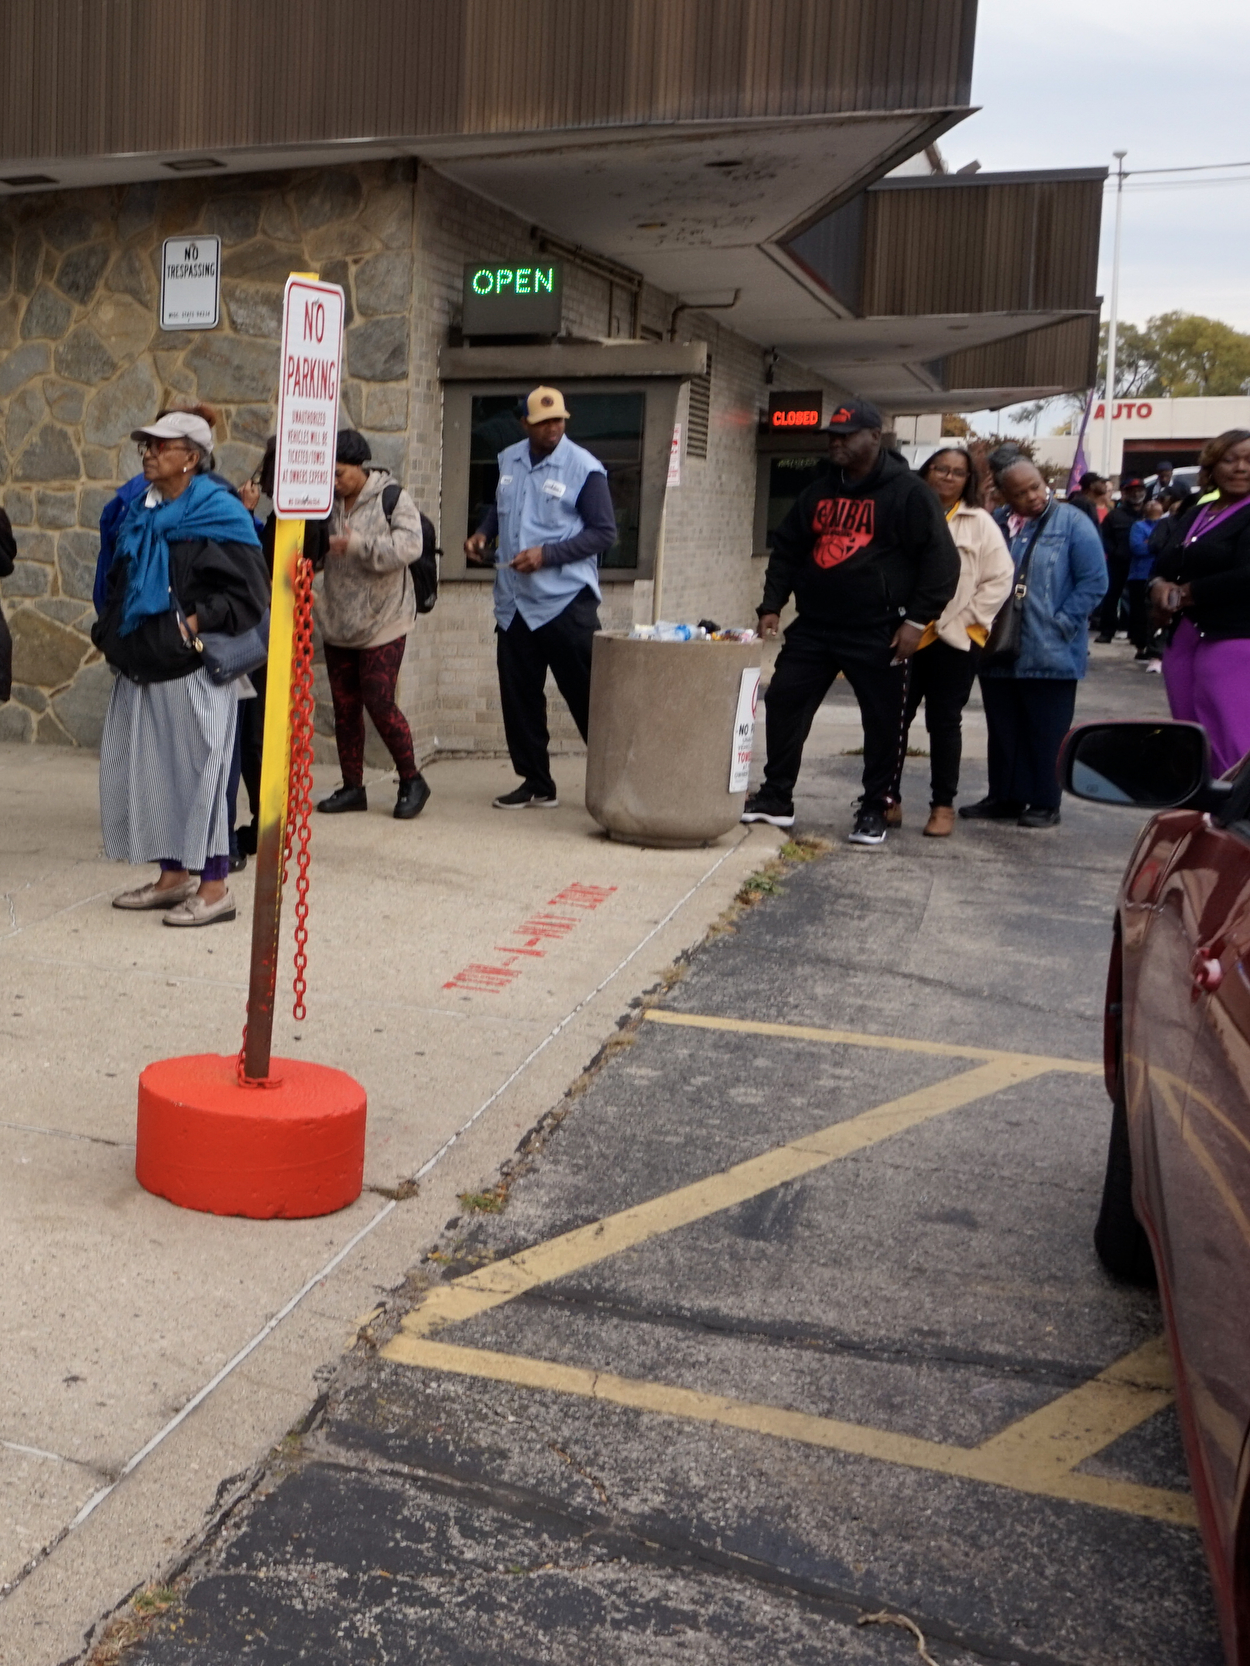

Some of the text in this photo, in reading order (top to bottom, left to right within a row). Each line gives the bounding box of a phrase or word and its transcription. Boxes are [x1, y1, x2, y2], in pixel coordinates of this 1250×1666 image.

[185, 246, 199, 261] NO
[167, 262, 215, 280] TRESPASSING
[473, 268, 553, 294] OPEN
[303, 301, 325, 344] NO
[286, 355, 336, 402] PARKING
[292, 409, 326, 426] UNAUTHORIZED
[772, 410, 818, 426] CLOSED
[1094, 403, 1152, 419] AUTO
[288, 429, 328, 446] VEHICLES WILL BE
[288, 448, 325, 465] TICKETED/TOWED
[282, 468, 288, 483] AT
[308, 469, 329, 485] EXPENSE
[739, 723, 749, 736] NO
